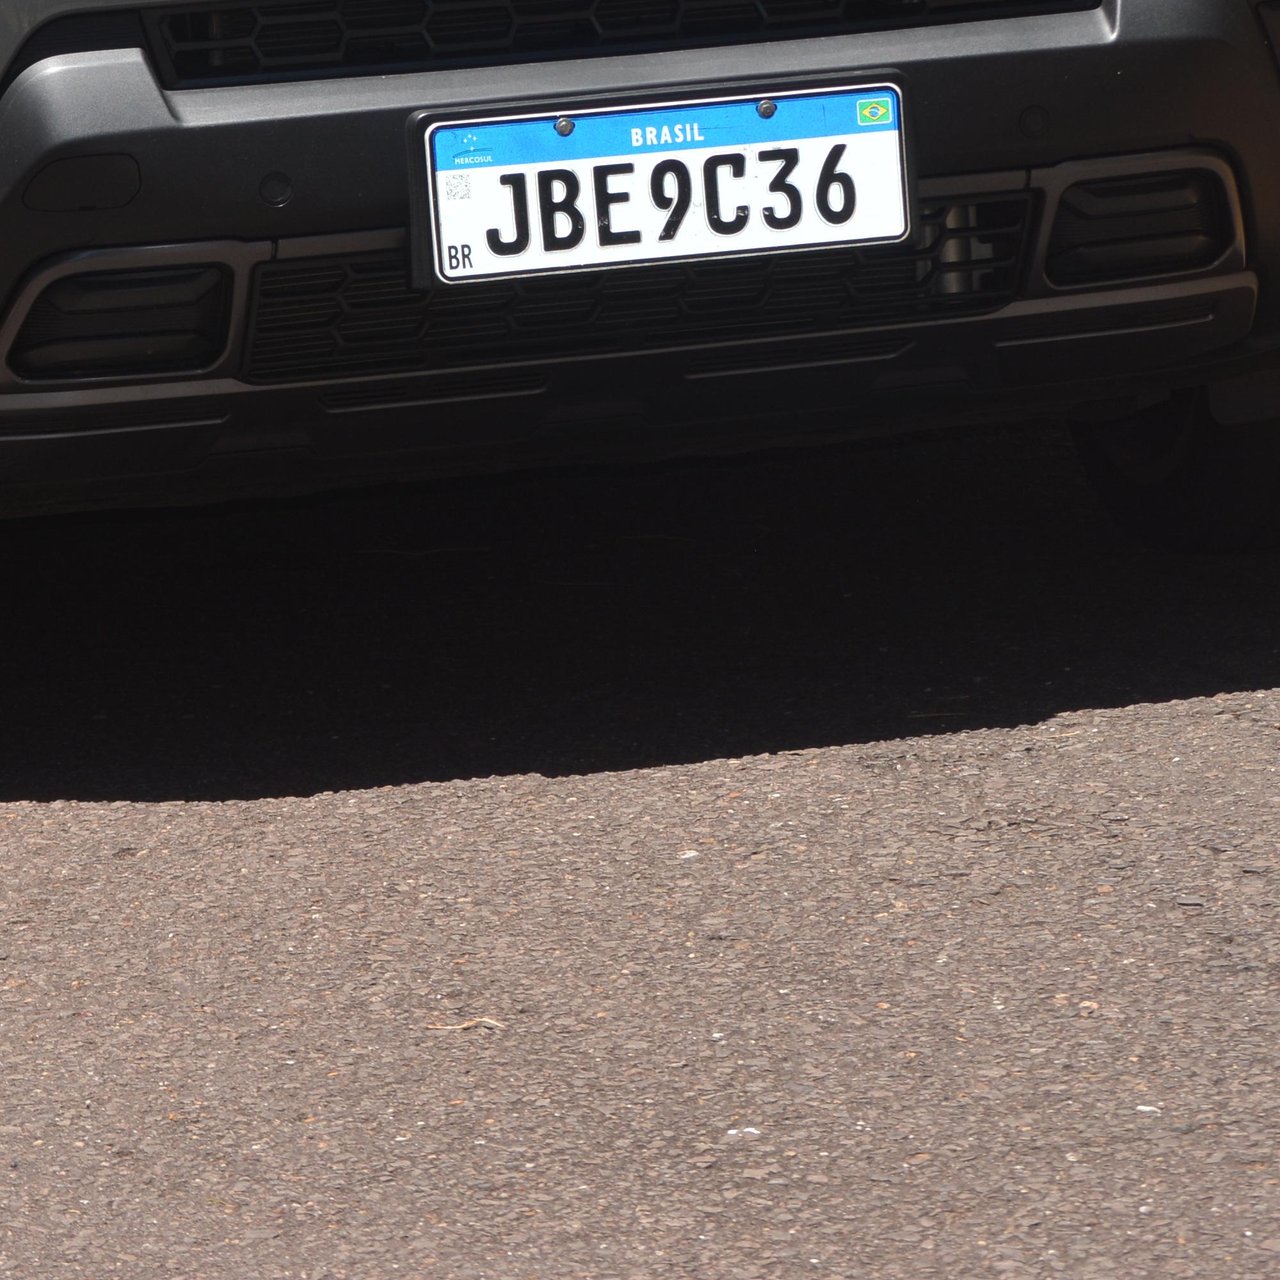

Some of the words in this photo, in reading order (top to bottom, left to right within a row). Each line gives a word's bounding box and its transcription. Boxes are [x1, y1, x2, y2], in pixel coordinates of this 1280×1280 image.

[630, 123, 705, 148] BRASIL
[454, 155, 493, 165] MERCOSUL
[485, 143, 857, 257] JBE9C36
[447, 244, 473, 270] BR
